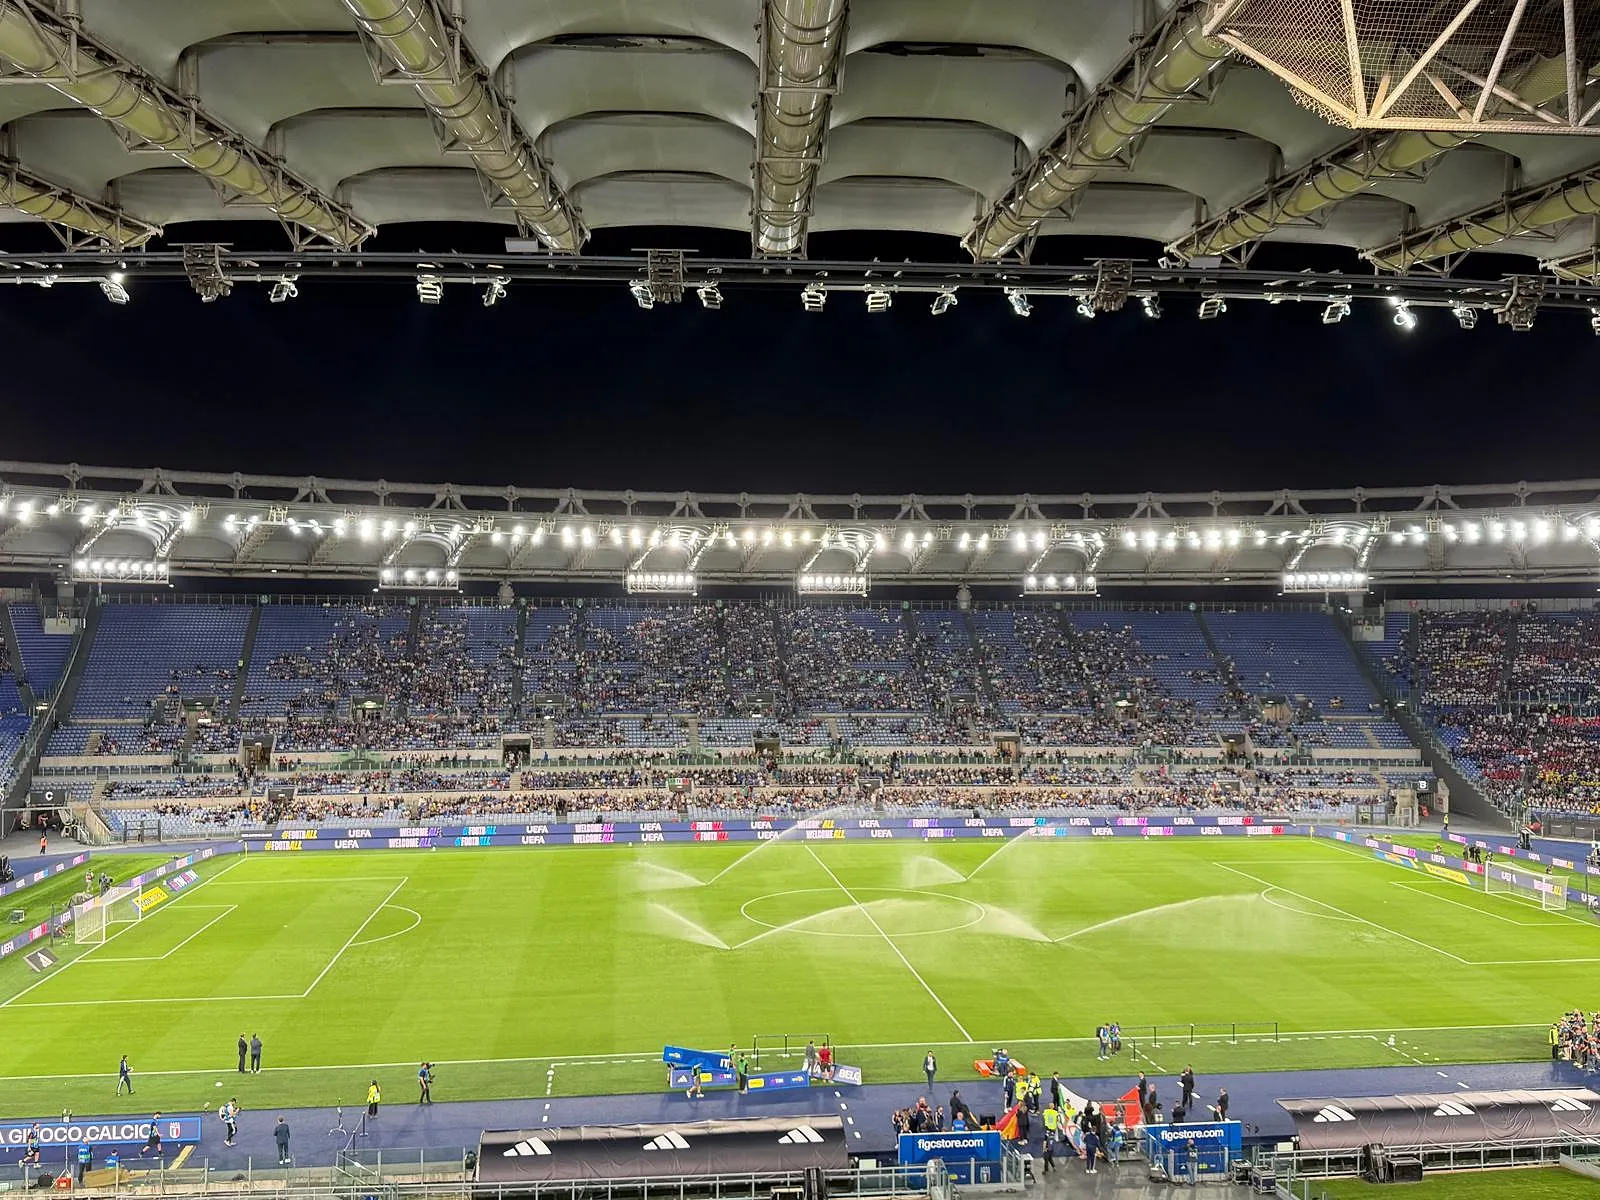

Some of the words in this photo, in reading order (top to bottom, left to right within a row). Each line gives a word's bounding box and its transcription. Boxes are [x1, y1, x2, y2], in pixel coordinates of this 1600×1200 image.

[46, 792, 54, 801] C
[859, 820, 880, 828] UEFA
[965, 819, 986, 827] UEFA
[1070, 818, 1090, 826] UEFA
[1174, 817, 1194, 825] UEFA
[526, 825, 548, 834] UEFA
[640, 823, 662, 831] UEFA
[1092, 827, 1113, 836] UEFA
[1200, 827, 1223, 835] UEFA
[348, 830, 372, 838] UEFA
[757, 831, 779, 840] UEFA
[871, 829, 892, 838] UEFA
[982, 828, 1004, 836] UEFA
[522, 836, 545, 844] UEFA
[641, 833, 664, 841] UEFA
[334, 840, 359, 848] UEFA
[1366, 839, 1379, 848] UEFA
[1431, 853, 1446, 864] UEFA
[60, 911, 71, 924] UEFA
[1, 941, 14, 955] UEFA
[86, 1124, 151, 1140] CALCIO
[1161, 1128, 1224, 1141] figcstore.com
[918, 1138, 984, 1150] figcstore.com
